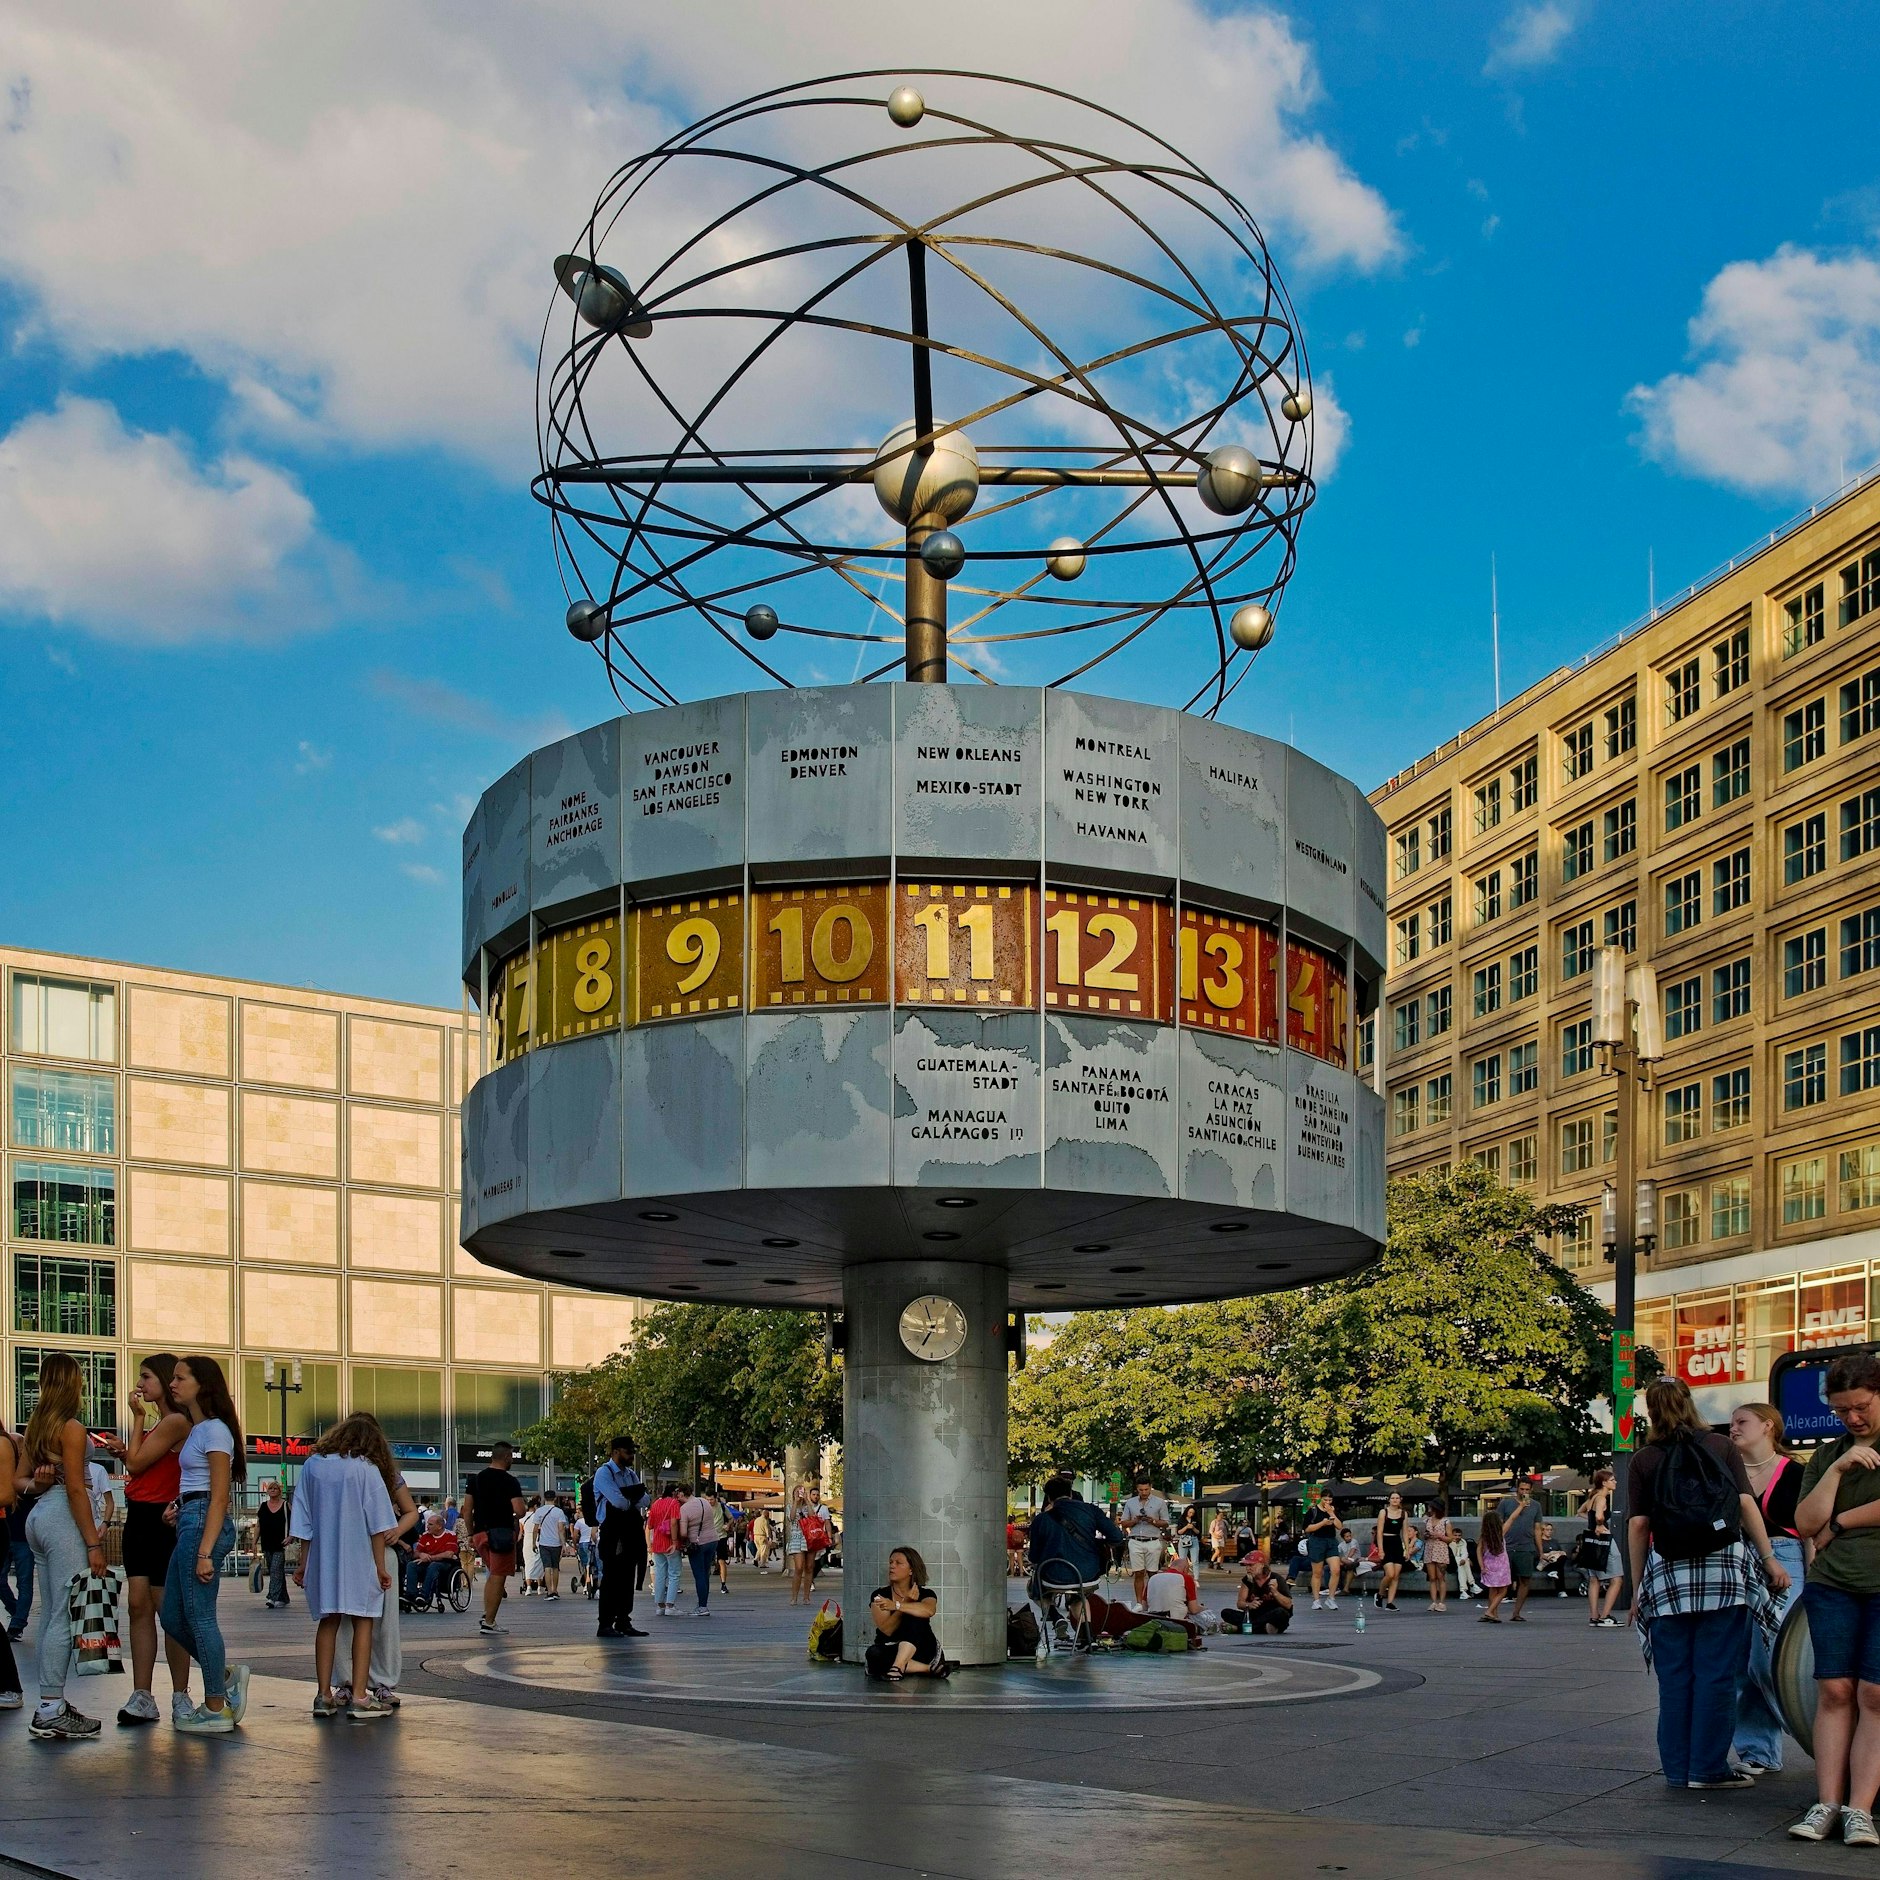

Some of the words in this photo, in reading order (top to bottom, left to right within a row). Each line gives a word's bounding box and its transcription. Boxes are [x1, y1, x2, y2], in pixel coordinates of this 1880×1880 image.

[644, 741, 720, 766] VANCOUVER
[781, 746, 858, 763] EDMONTON
[917, 746, 950, 760] NEW
[955, 747, 1021, 762] ORLEANS
[1075, 737, 1151, 761] MONTREAL
[654, 760, 709, 781] DAWSON
[791, 764, 847, 779] DENVER
[1209, 765, 1259, 791] HALIFAX
[633, 786, 656, 802] SAN
[662, 772, 732, 796] FRANCISCO
[916, 780, 1022, 796] MEXIKO-STADT
[1063, 769, 1161, 796] WASHINGTON
[561, 791, 586, 811] NOME
[643, 801, 663, 816] LOS
[667, 792, 720, 813] ANGELES
[1075, 788, 1107, 804] NEW
[1113, 793, 1150, 811] YORK
[549, 803, 599, 831] FAIRBANKS
[546, 817, 603, 848] ANCHORAGE
[1077, 821, 1148, 844] HAVANNA
[769, 904, 874, 983] 10
[914, 903, 994, 980] 11
[1045, 910, 1139, 992] 12
[666, 916, 721, 995] 9
[1180, 925, 1244, 1009] 13
[573, 937, 614, 1014] 8
[916, 1058, 1018, 1074] GUATEMALA-
[1082, 1065, 1142, 1083] PANAMA
[973, 1076, 1019, 1090] STADT
[1208, 1081, 1260, 1100] CARACAS
[1214, 1098, 1228, 1112] LA
[1233, 1101, 1253, 1115] PAZ
[1305, 1084, 1340, 1106] BRASILIA
[928, 1110, 1008, 1124] MANAGUA
[1094, 1100, 1131, 1115] QUITO
[1295, 1096, 1307, 1110] RIO
[1308, 1101, 1317, 1114] DE
[1319, 1103, 1349, 1125] JANEIRO
[911, 1123, 999, 1140] GALÁPAGOS
[1095, 1117, 1129, 1132] LIMA
[1206, 1112, 1262, 1133] ASUNCIÓN
[1304, 1112, 1318, 1129] SÃO
[1320, 1121, 1341, 1137] PAULO
[1301, 1129, 1343, 1152] MONTEVIDEO
[1297, 1143, 1325, 1163] BUENOS
[1326, 1154, 1346, 1169] AIRES
[1804, 1305, 1865, 1336] FIVE
[1694, 1323, 1746, 1352] FIVE
[1687, 1349, 1748, 1377] GUYS
[1785, 1413, 1845, 1430] Alexande
